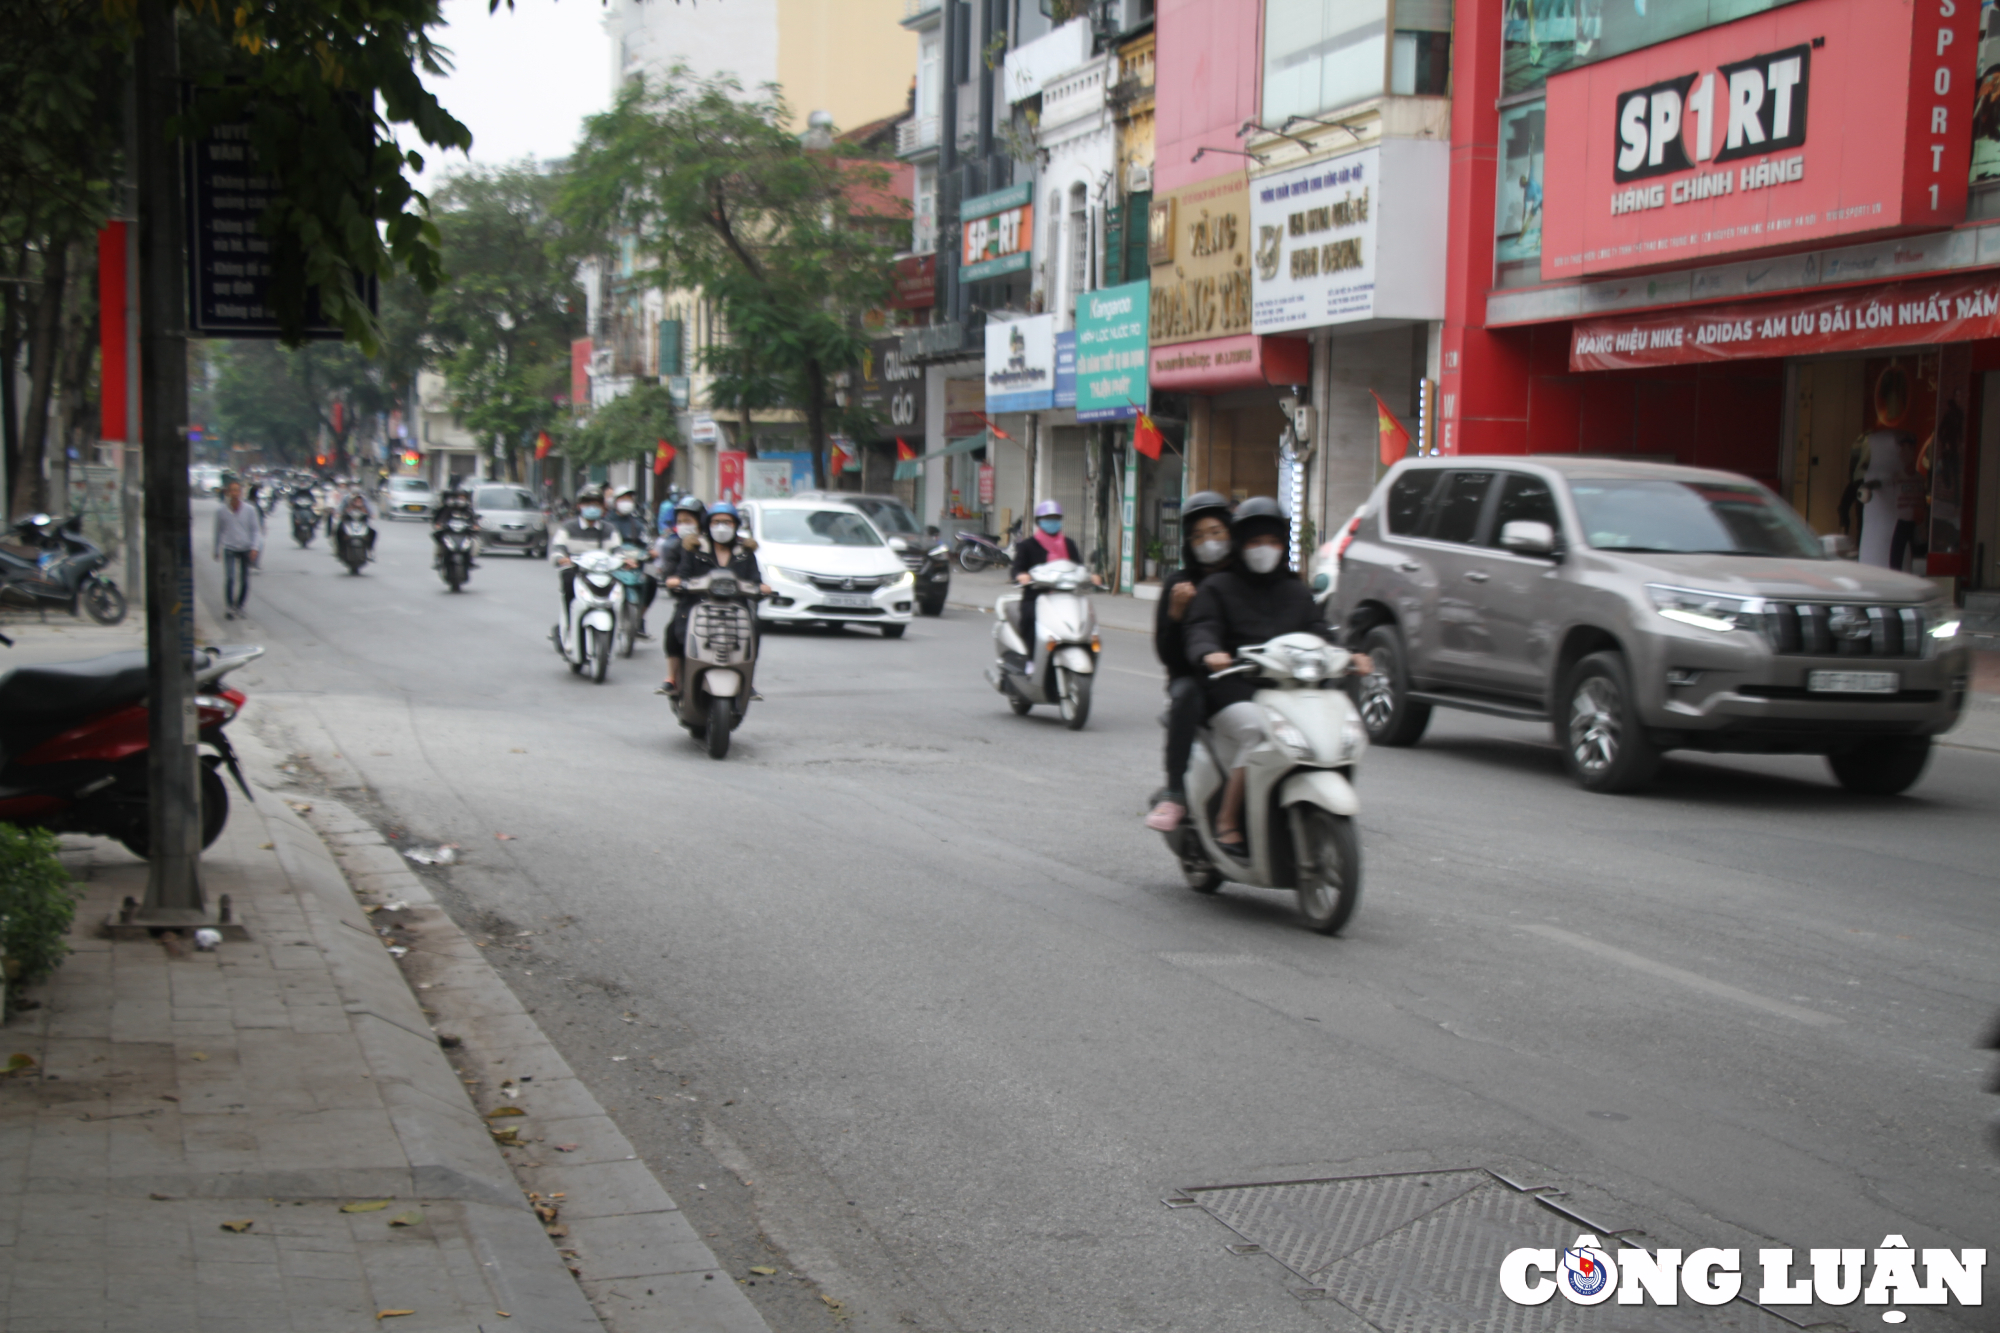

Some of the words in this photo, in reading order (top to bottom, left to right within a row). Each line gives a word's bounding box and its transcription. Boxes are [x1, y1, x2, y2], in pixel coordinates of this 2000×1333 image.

[1611, 186, 1665, 216] HÀNG
[1671, 172, 1734, 205] CHÍNH
[1740, 157, 1804, 191] HÃNG
[1576, 332, 1613, 355] HÀNG
[1616, 327, 1648, 356] HIỆU
[1650, 327, 1684, 349] NIKE
[1695, 320, 1753, 345] ADIDAS
[1819, 305, 1851, 333] ĐÃI
[1856, 300, 1893, 330] LỚN
[1899, 291, 1951, 325] NHẤT
[1956, 289, 2000, 320] NĂM
